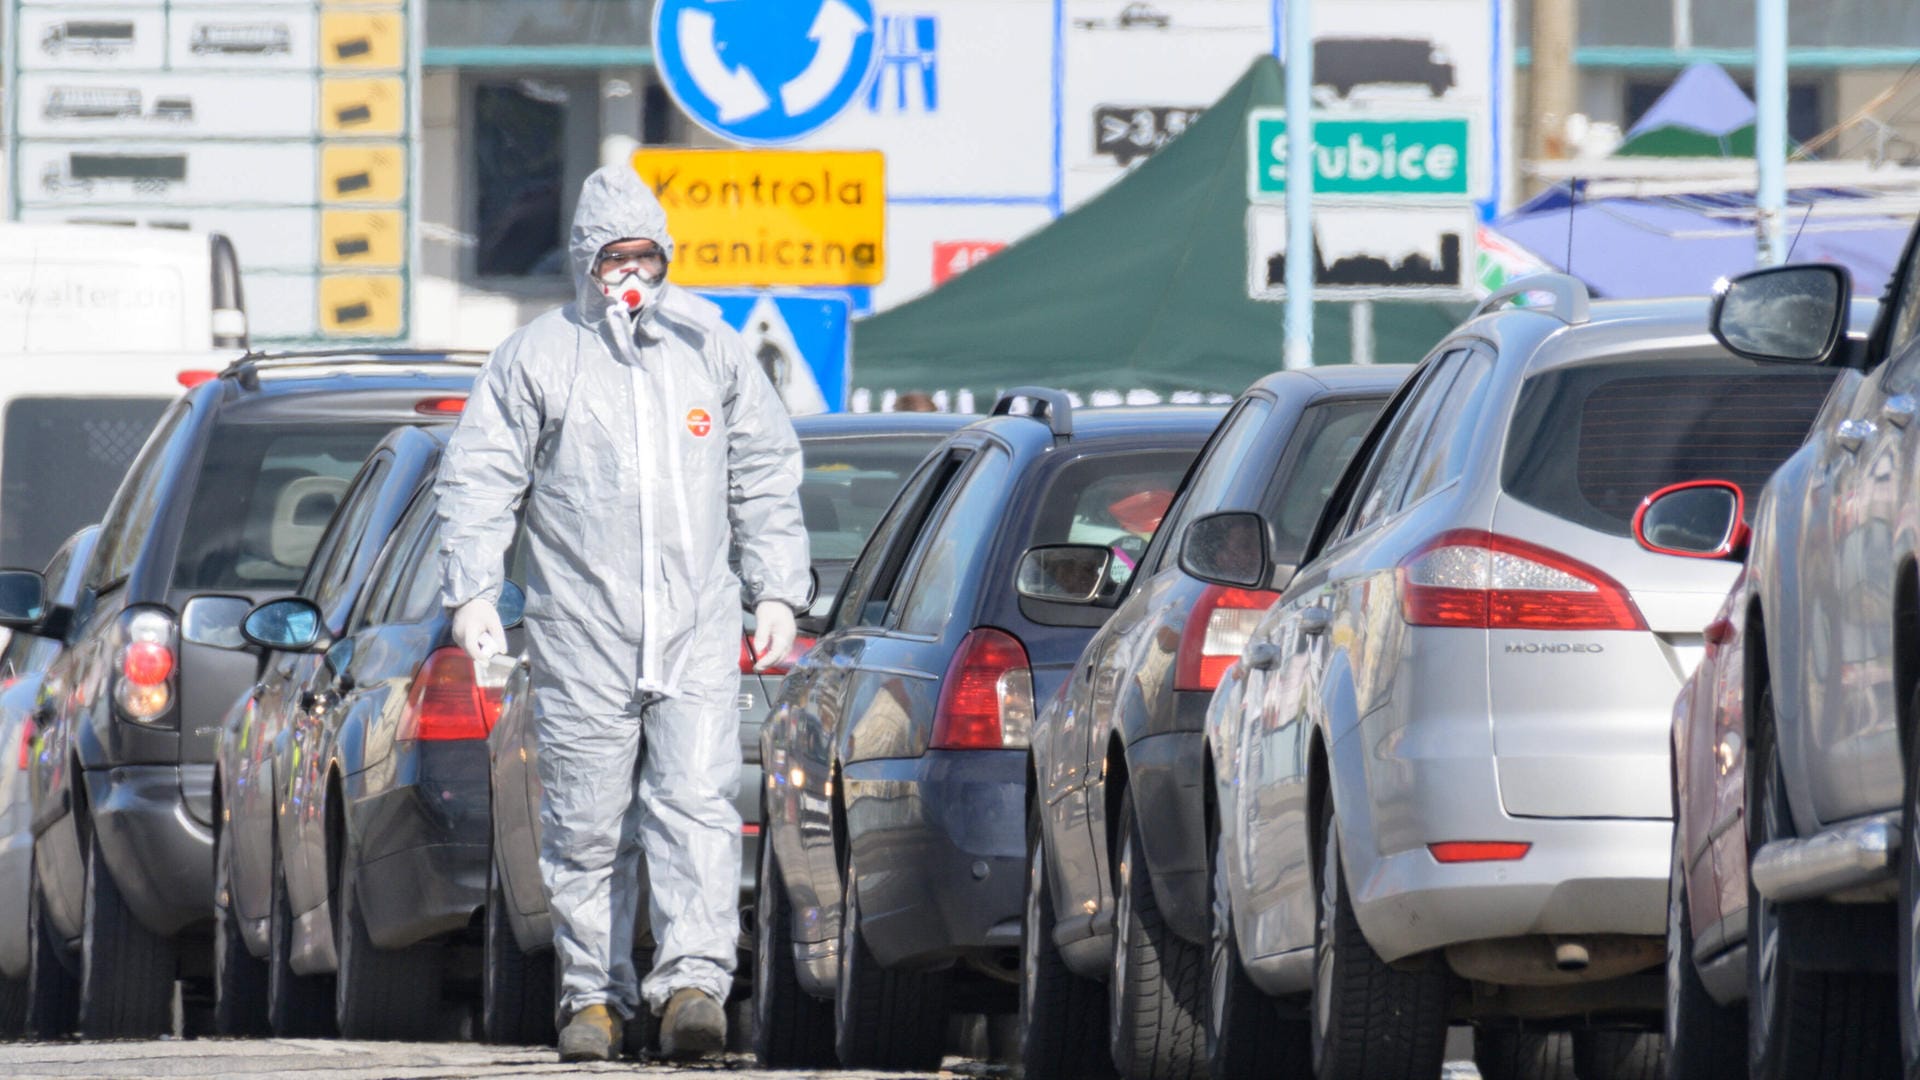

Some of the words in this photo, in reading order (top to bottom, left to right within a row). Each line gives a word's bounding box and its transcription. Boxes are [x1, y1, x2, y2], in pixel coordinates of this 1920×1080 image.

[1268, 133, 1458, 180] Subice
[654, 168, 864, 205] Kontrola
[677, 227, 876, 266] raniczna
[1505, 643, 1604, 654] MONDEO
